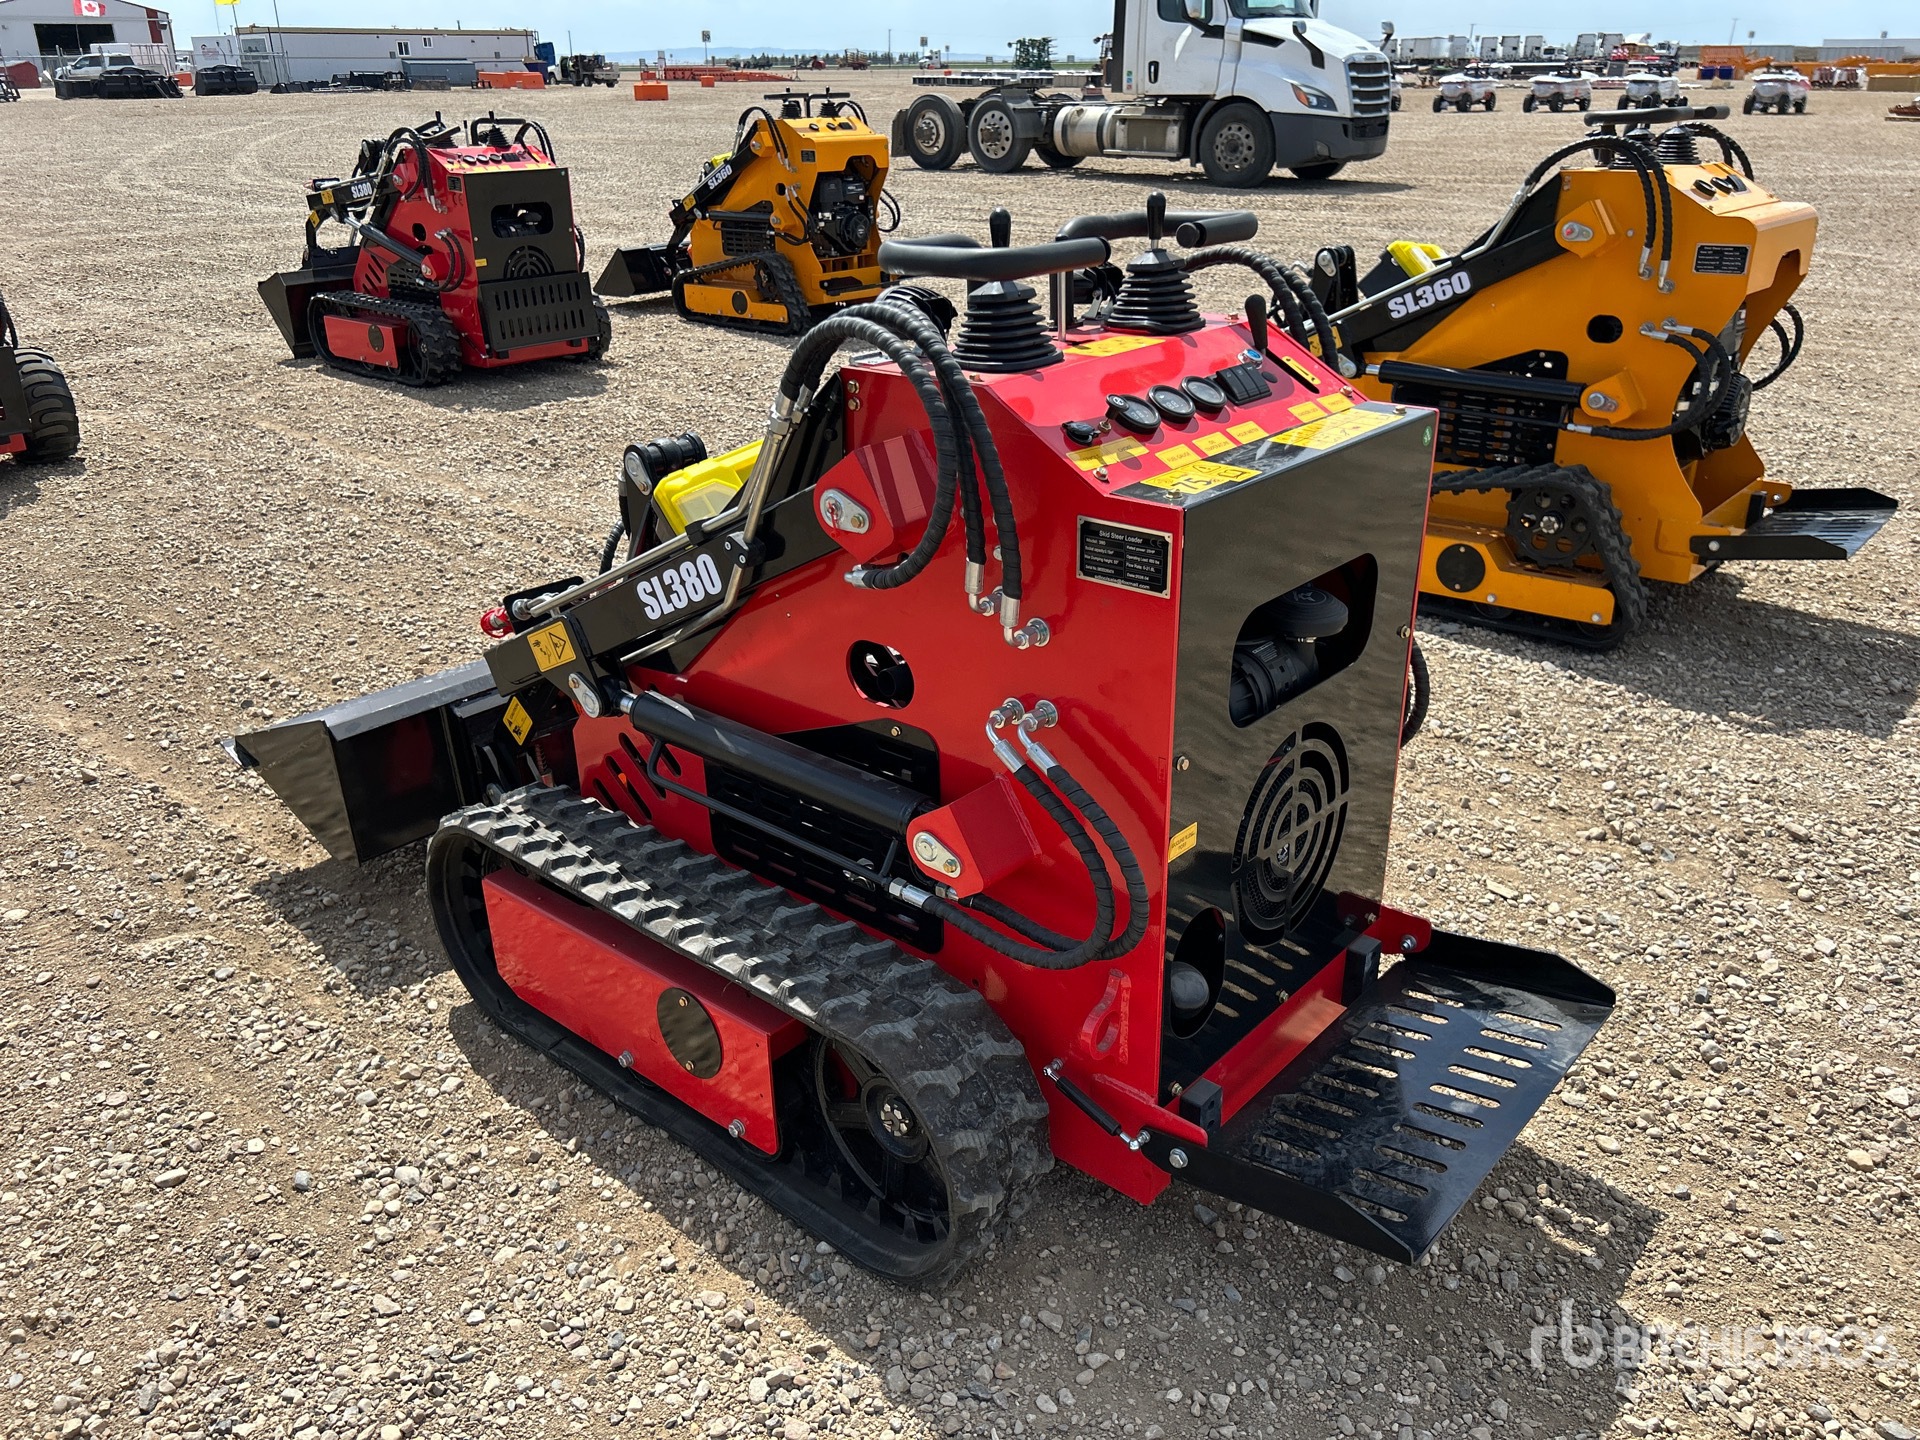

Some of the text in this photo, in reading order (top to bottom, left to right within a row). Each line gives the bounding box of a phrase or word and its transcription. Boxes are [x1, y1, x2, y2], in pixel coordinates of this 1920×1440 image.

[351, 182, 372, 198] SL380
[708, 164, 732, 190] SL360
[1387, 271, 1471, 319] SL360
[1098, 530, 1143, 544] Skid Steer Loader
[636, 554, 722, 620] SL380
